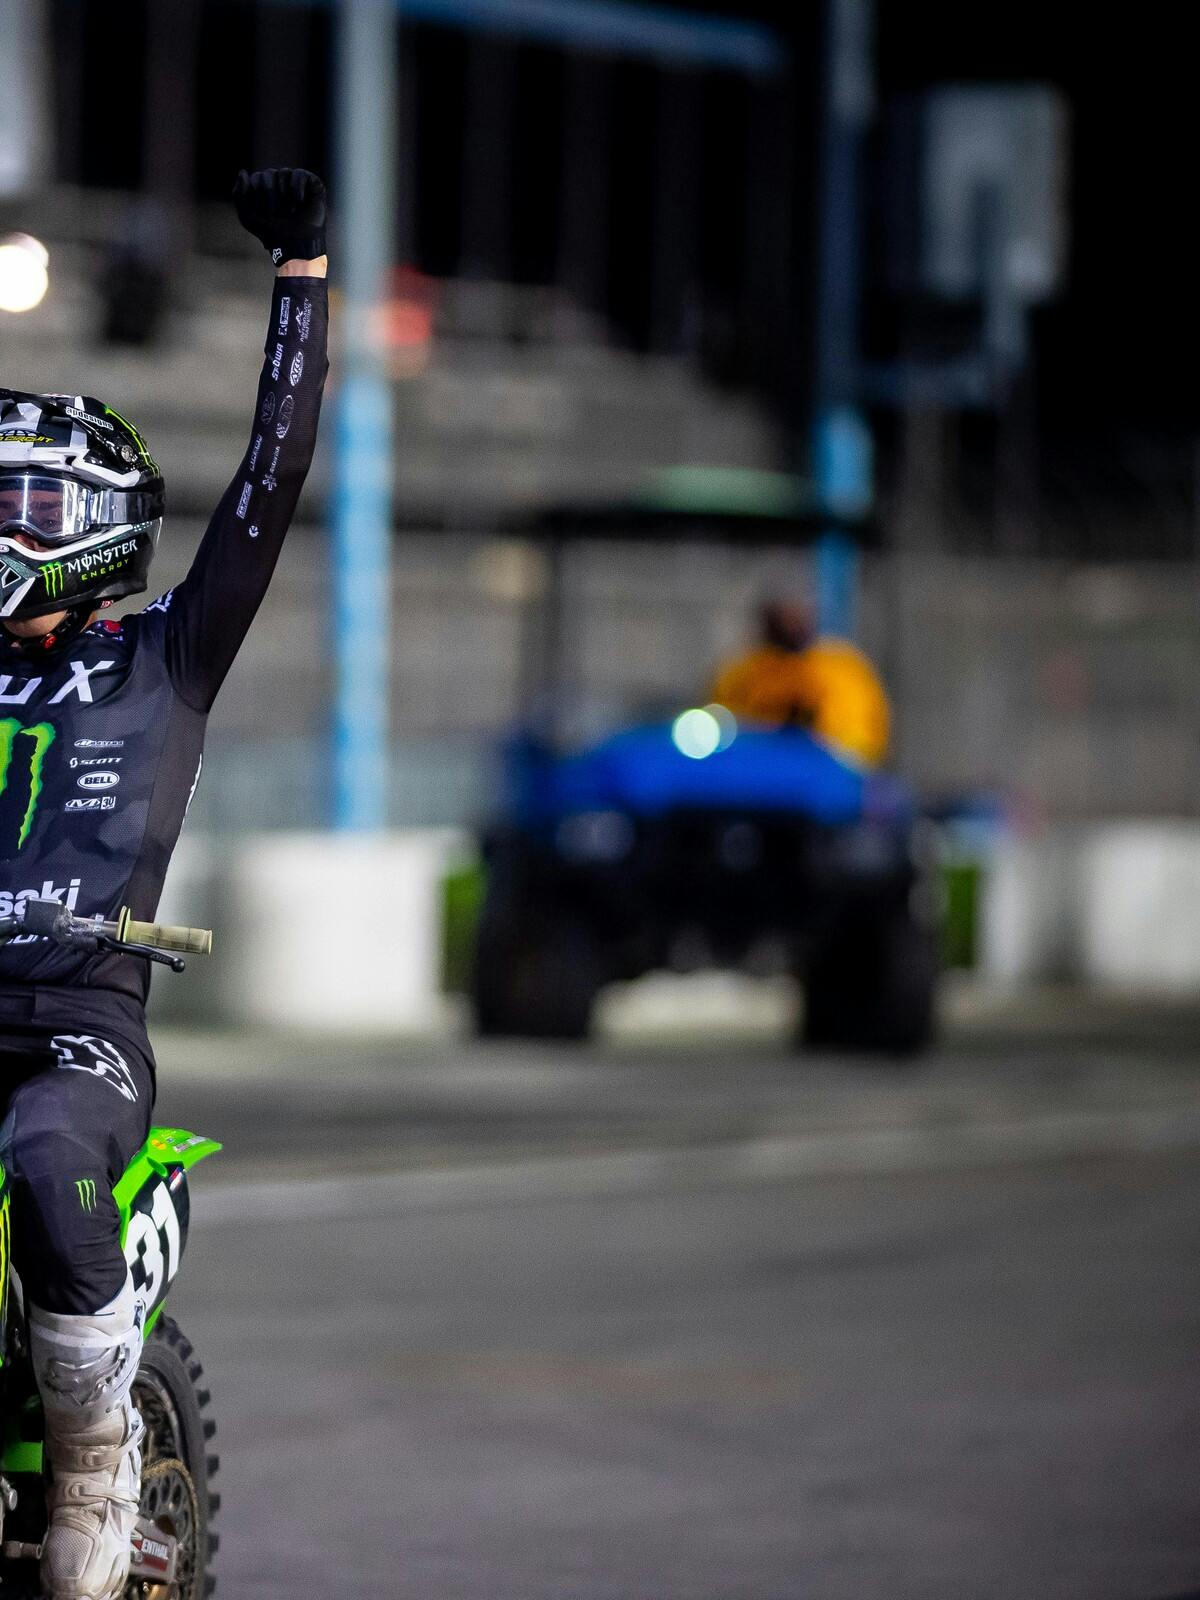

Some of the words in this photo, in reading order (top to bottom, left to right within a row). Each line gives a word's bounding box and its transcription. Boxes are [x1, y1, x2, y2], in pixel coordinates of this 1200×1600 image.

[4, 434, 56, 444] CIRCUIT
[81, 558, 129, 581] ENERGY
[80, 757, 124, 766] SCOTT
[84, 776, 113, 785] BELL
